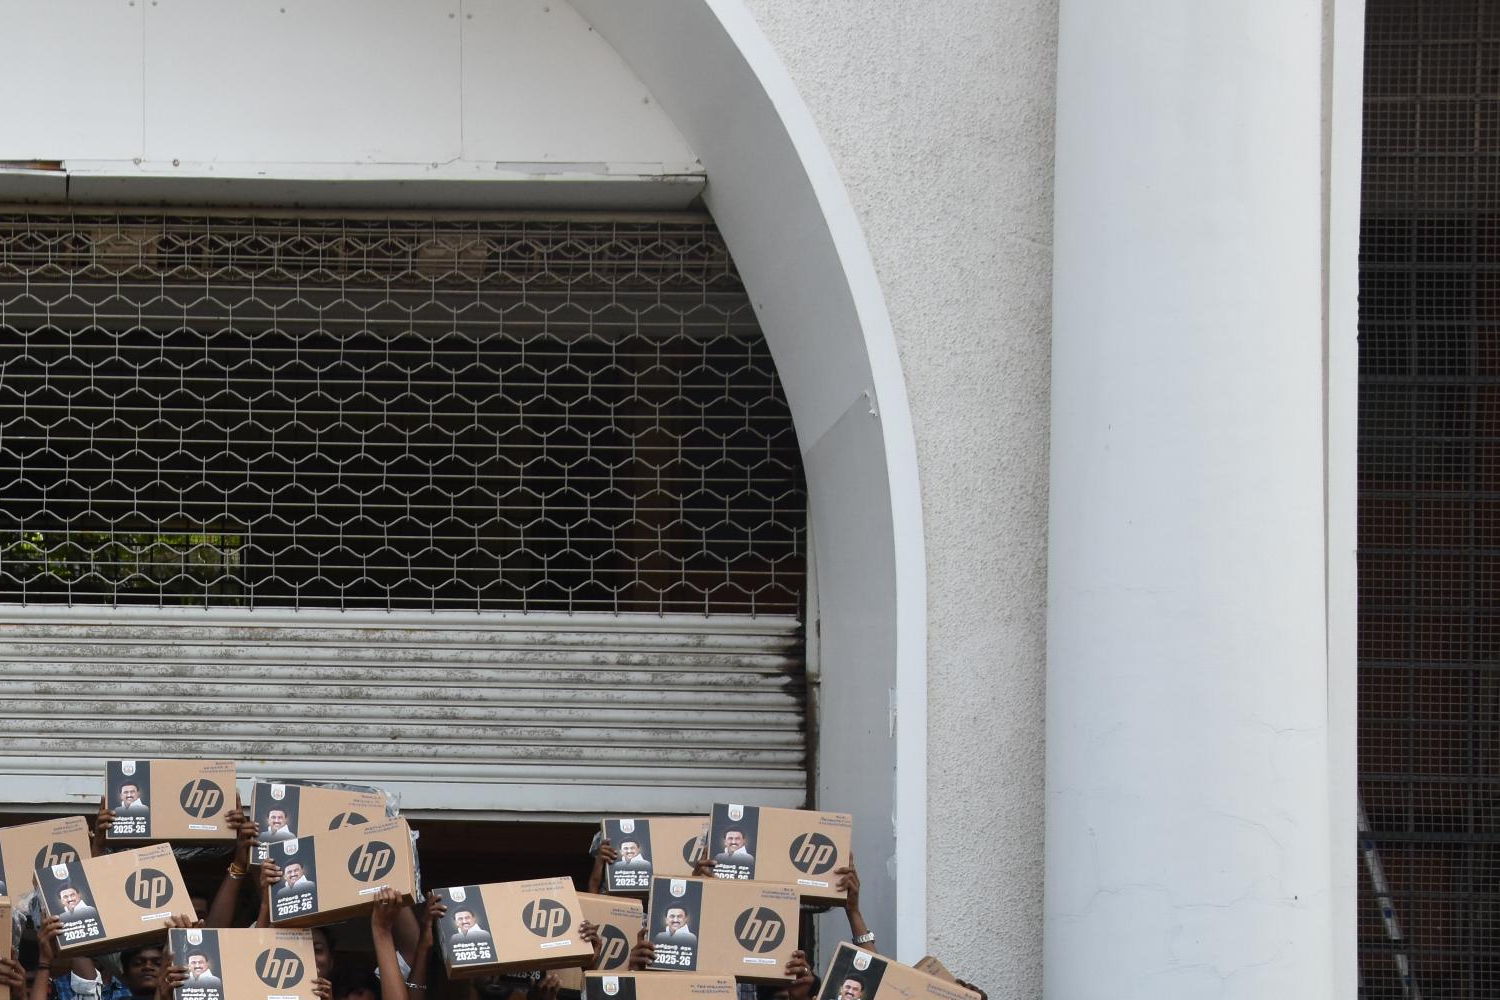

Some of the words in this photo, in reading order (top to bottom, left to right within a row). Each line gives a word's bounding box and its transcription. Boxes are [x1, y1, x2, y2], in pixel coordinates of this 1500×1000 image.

[184, 779, 220, 818] hp
[114, 824, 146, 834] 2025-26
[353, 842, 391, 882] hp
[794, 832, 834, 875] hp
[134, 869, 166, 909] hp
[615, 877, 649, 887] 2025-26
[278, 900, 313, 916] 2025-26
[530, 899, 565, 938] hp
[63, 925, 101, 941] 2025-26
[739, 906, 781, 953] hp
[262, 947, 299, 989] hp
[454, 949, 492, 961] 2025-26
[654, 953, 691, 967] 2025-26
